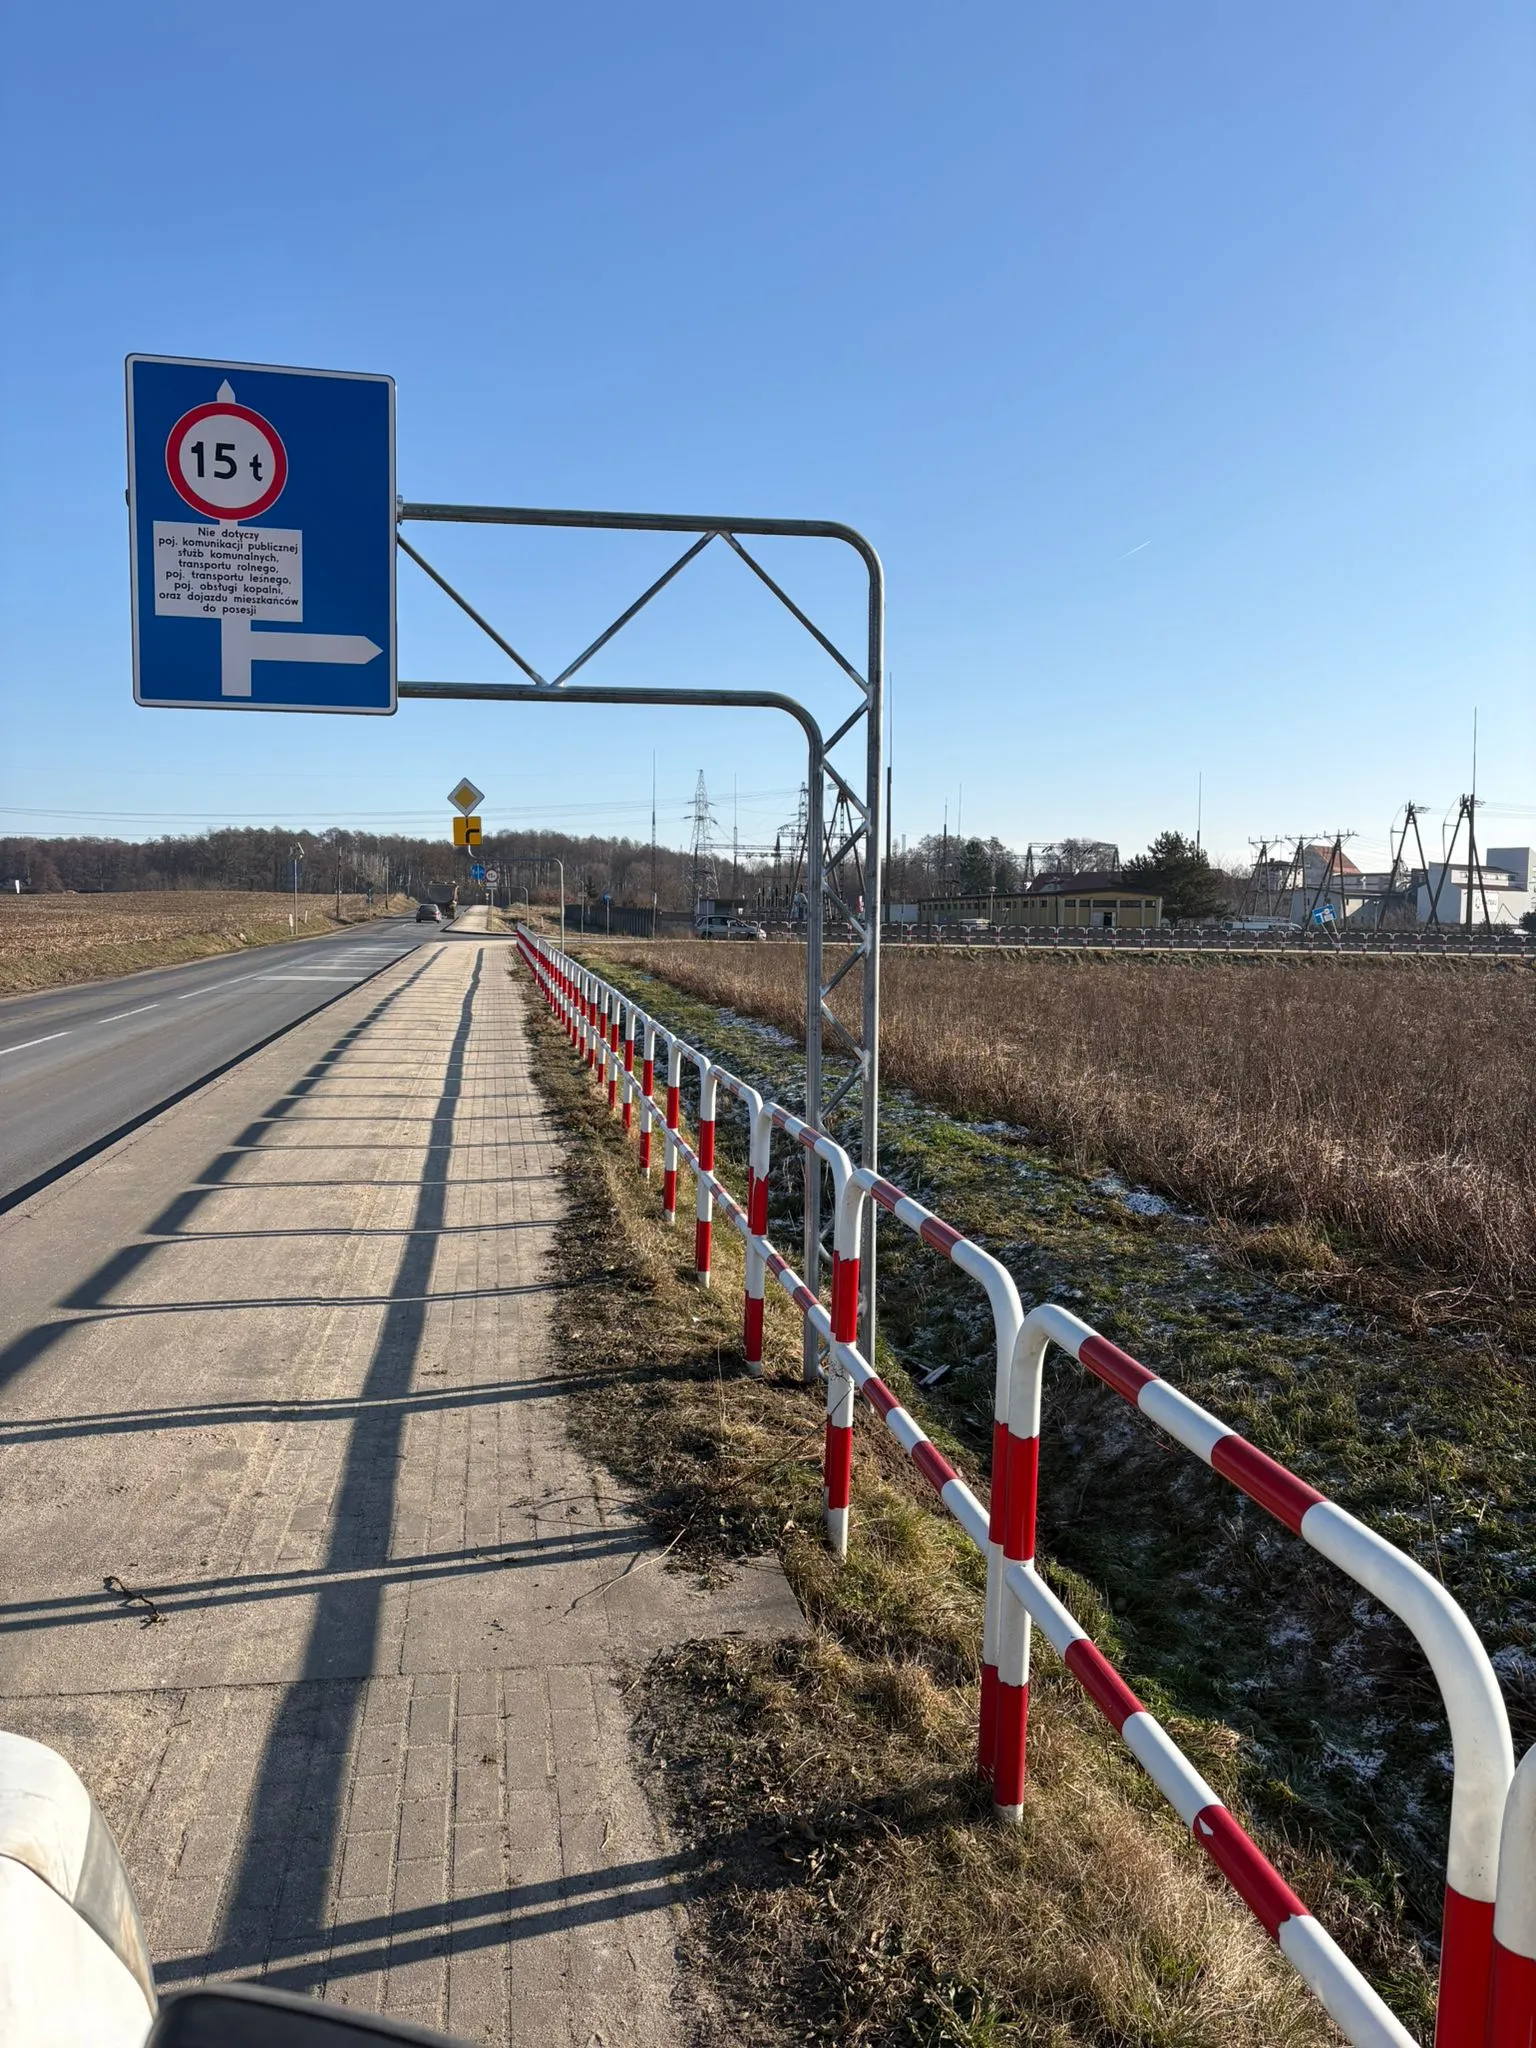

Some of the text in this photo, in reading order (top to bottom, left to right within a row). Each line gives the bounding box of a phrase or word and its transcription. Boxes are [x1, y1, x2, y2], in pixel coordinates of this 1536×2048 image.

[191, 441, 264, 482] 15 t
[198, 527, 260, 541] Nie dotyczy
[159, 536, 178, 547] poj.
[182, 537, 243, 551] komunikacji
[178, 548, 279, 563] służb komunalnych,
[178, 559, 231, 571] transportu
[166, 569, 185, 580] poj.
[191, 571, 244, 582] transportu
[174, 580, 193, 591] poj.
[200, 582, 237, 594] obsługi
[159, 592, 299, 606] oraz dojazdu mieszkańców
[202, 603, 257, 616] do posesji
